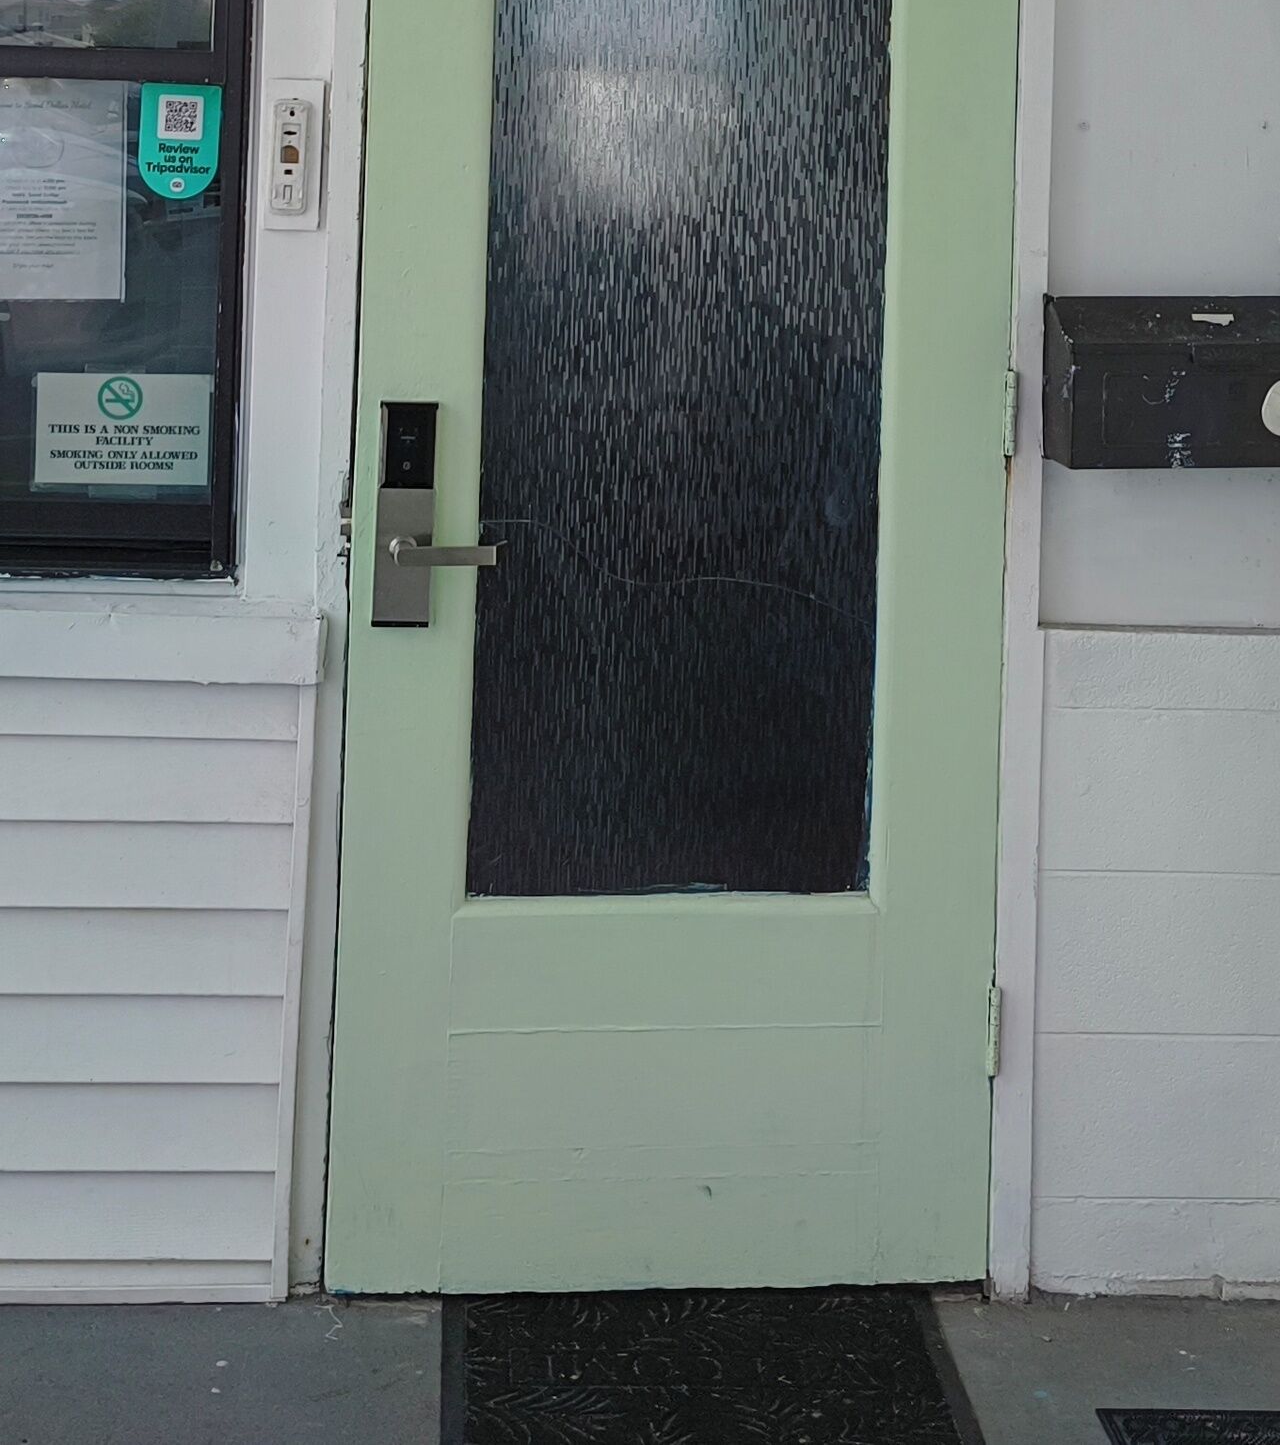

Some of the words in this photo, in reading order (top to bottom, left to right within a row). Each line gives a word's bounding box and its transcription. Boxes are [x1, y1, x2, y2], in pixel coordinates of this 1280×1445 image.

[158, 142, 200, 155] Review
[164, 154, 176, 163] us
[178, 156, 193, 164] on
[145, 161, 211, 175] Tripadvisor
[48, 424, 80, 434] THIS
[84, 424, 96, 434] IS
[100, 424, 109, 434] A
[114, 424, 139, 435] NON
[143, 425, 201, 436] SMOKING
[95, 436, 154, 446] FACILITY
[49, 449, 103, 460] SMOKING
[107, 450, 139, 460] ONLY
[140, 450, 198, 461] ALLOWED
[74, 460, 127, 471] OUTSIDE
[130, 461, 174, 471] ROOMS!
